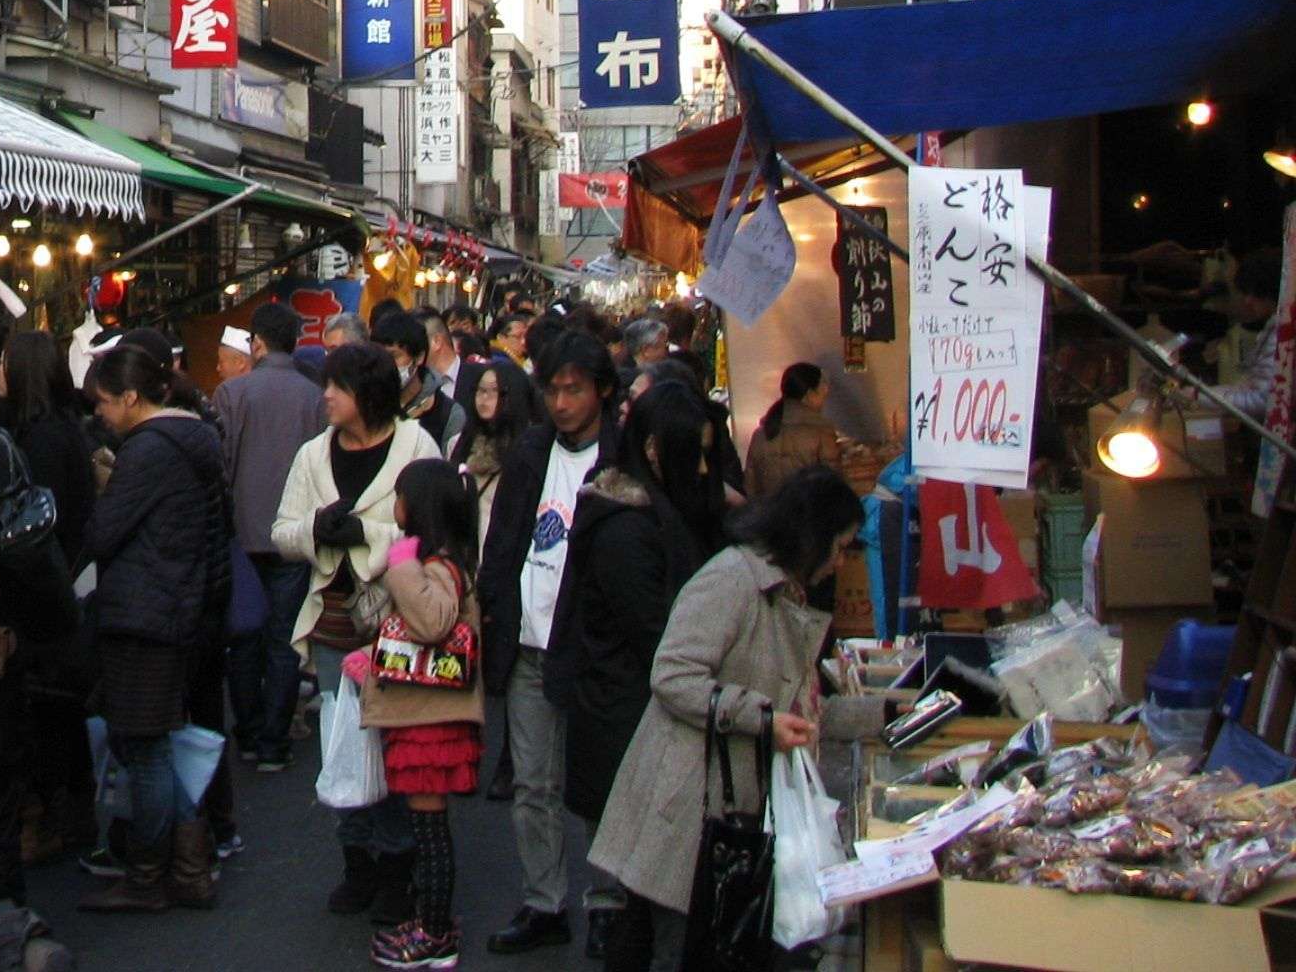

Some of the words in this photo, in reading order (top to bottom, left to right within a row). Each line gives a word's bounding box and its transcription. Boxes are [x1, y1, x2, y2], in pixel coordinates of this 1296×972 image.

[420, 134, 452, 145] ミヤコ
[934, 180, 979, 307] どんこ
[980, 174, 1016, 287] 格安
